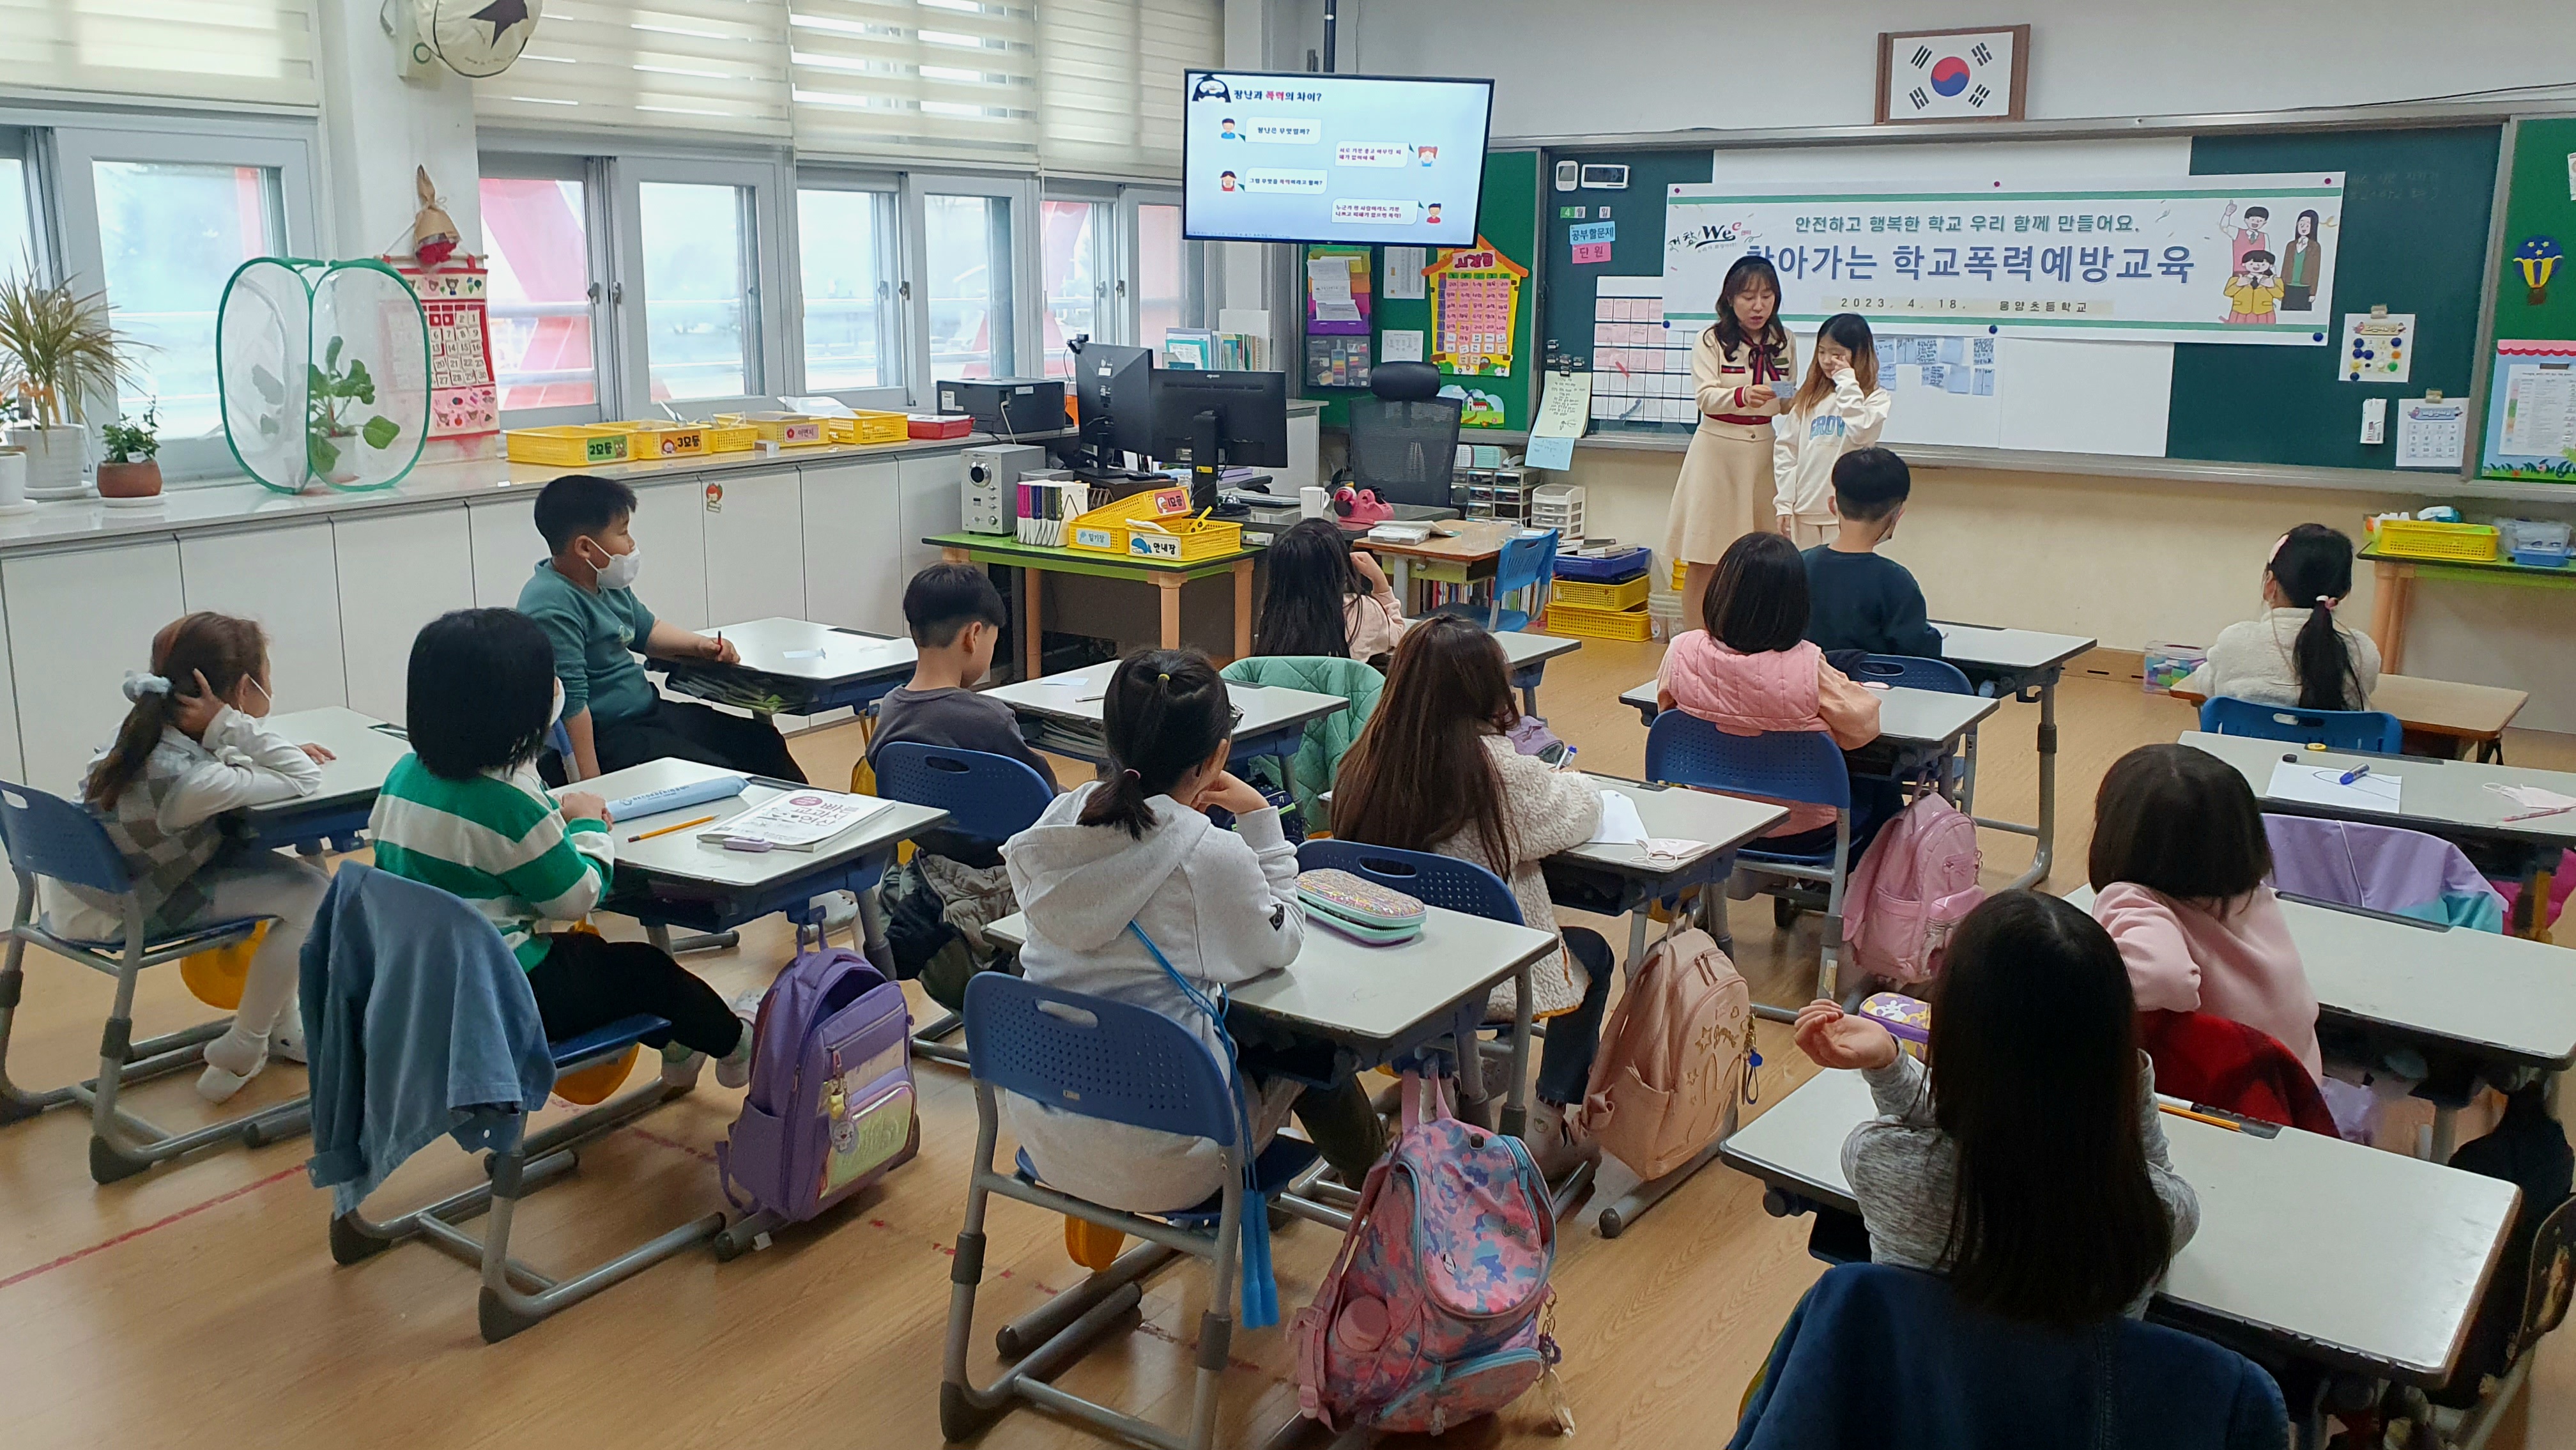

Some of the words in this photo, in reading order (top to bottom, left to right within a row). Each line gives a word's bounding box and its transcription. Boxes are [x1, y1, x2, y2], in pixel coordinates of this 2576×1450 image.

[1296, 91, 1322, 102] 차이?
[1795, 215, 1861, 233] 안전하고
[1869, 215, 1920, 233] 행복한
[1928, 215, 1962, 232] 학교
[1970, 215, 2005, 233] 우리
[2014, 214, 2049, 233] 함께
[2057, 213, 2140, 234] 만들어요.
[1571, 225, 1614, 242] 공부할문제
[1892, 244, 2195, 284] 학교폭력예방교육
[1841, 297, 1894, 309] 2023.
[1908, 298, 1924, 309] 4.
[1939, 298, 1966, 310] 18.
[447, 344, 456, 353] 14
[472, 343, 481, 351] 16
[677, 435, 700, 447] 3모둠
[1153, 542, 1176, 555] 안내장
